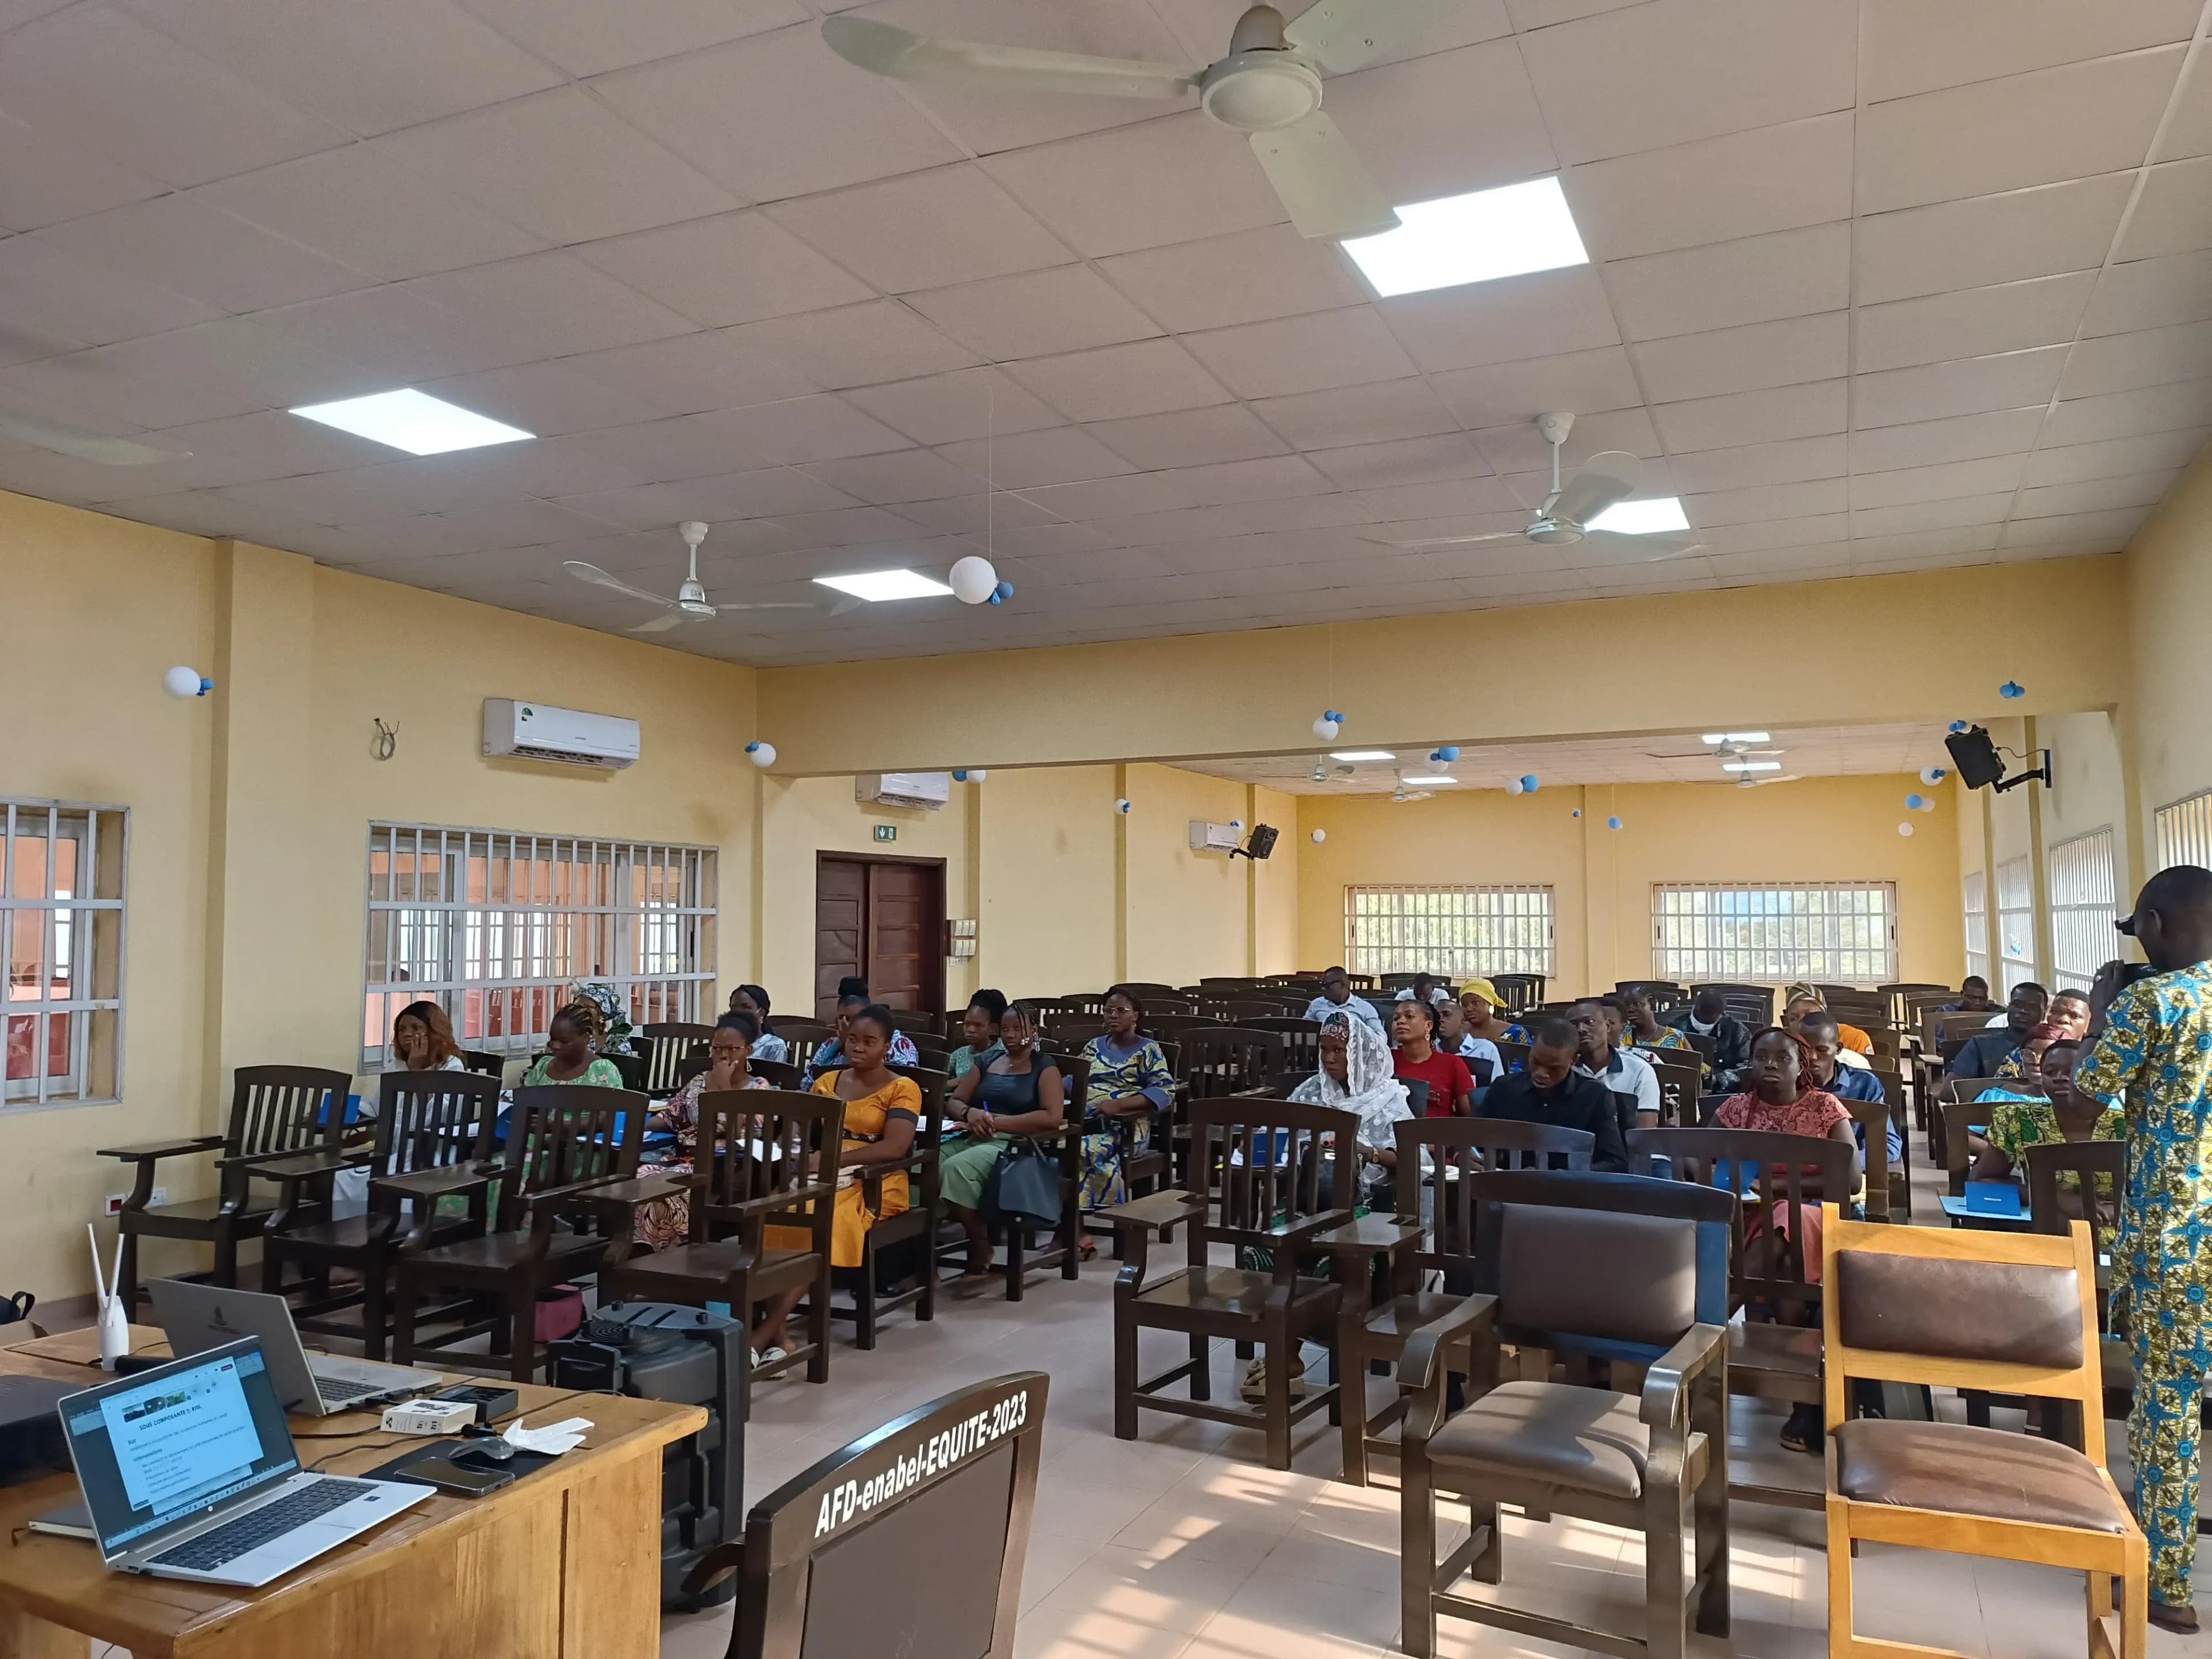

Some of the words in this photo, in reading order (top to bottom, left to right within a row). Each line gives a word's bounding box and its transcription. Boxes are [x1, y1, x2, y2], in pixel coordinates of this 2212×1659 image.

[139, 1421, 153, 1431] SOUS
[153, 1410, 185, 1426] COMPOSANTE
[815, 1390, 1027, 1538] AFD-enabel-EQUITE-2023
